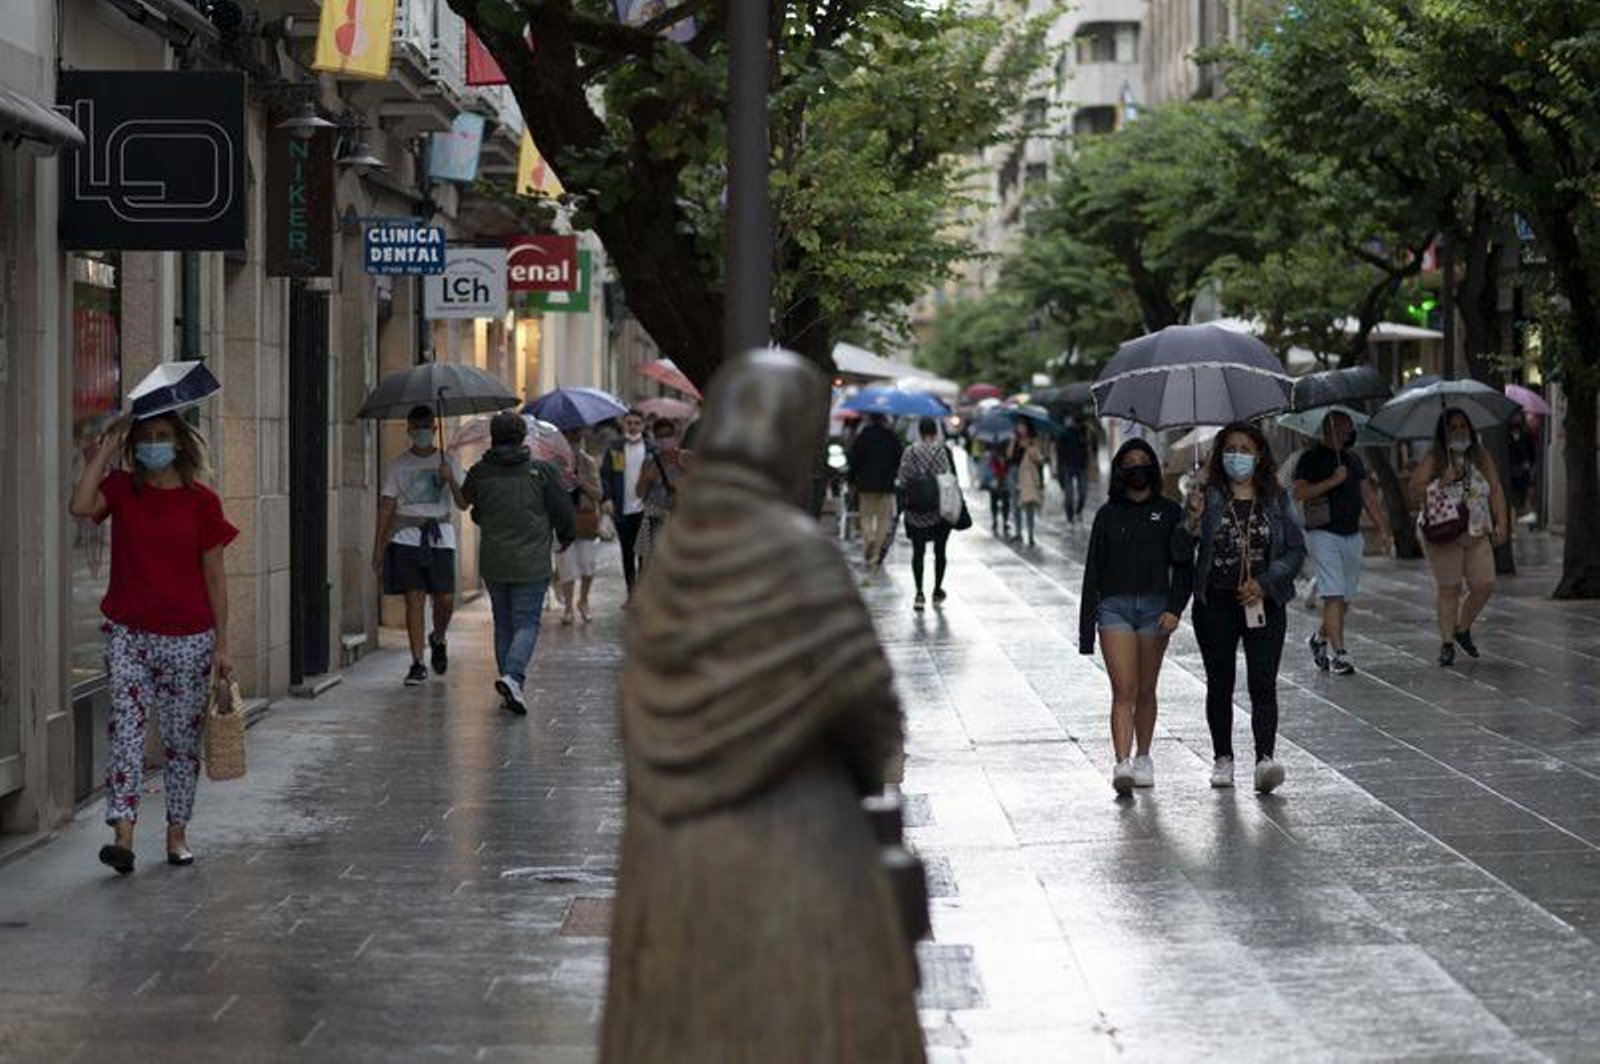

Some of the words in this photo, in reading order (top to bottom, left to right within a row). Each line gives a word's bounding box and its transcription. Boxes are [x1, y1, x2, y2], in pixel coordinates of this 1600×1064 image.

[367, 227, 441, 244] CLINICA
[370, 247, 439, 263] DENTAL
[508, 259, 569, 283] enal
